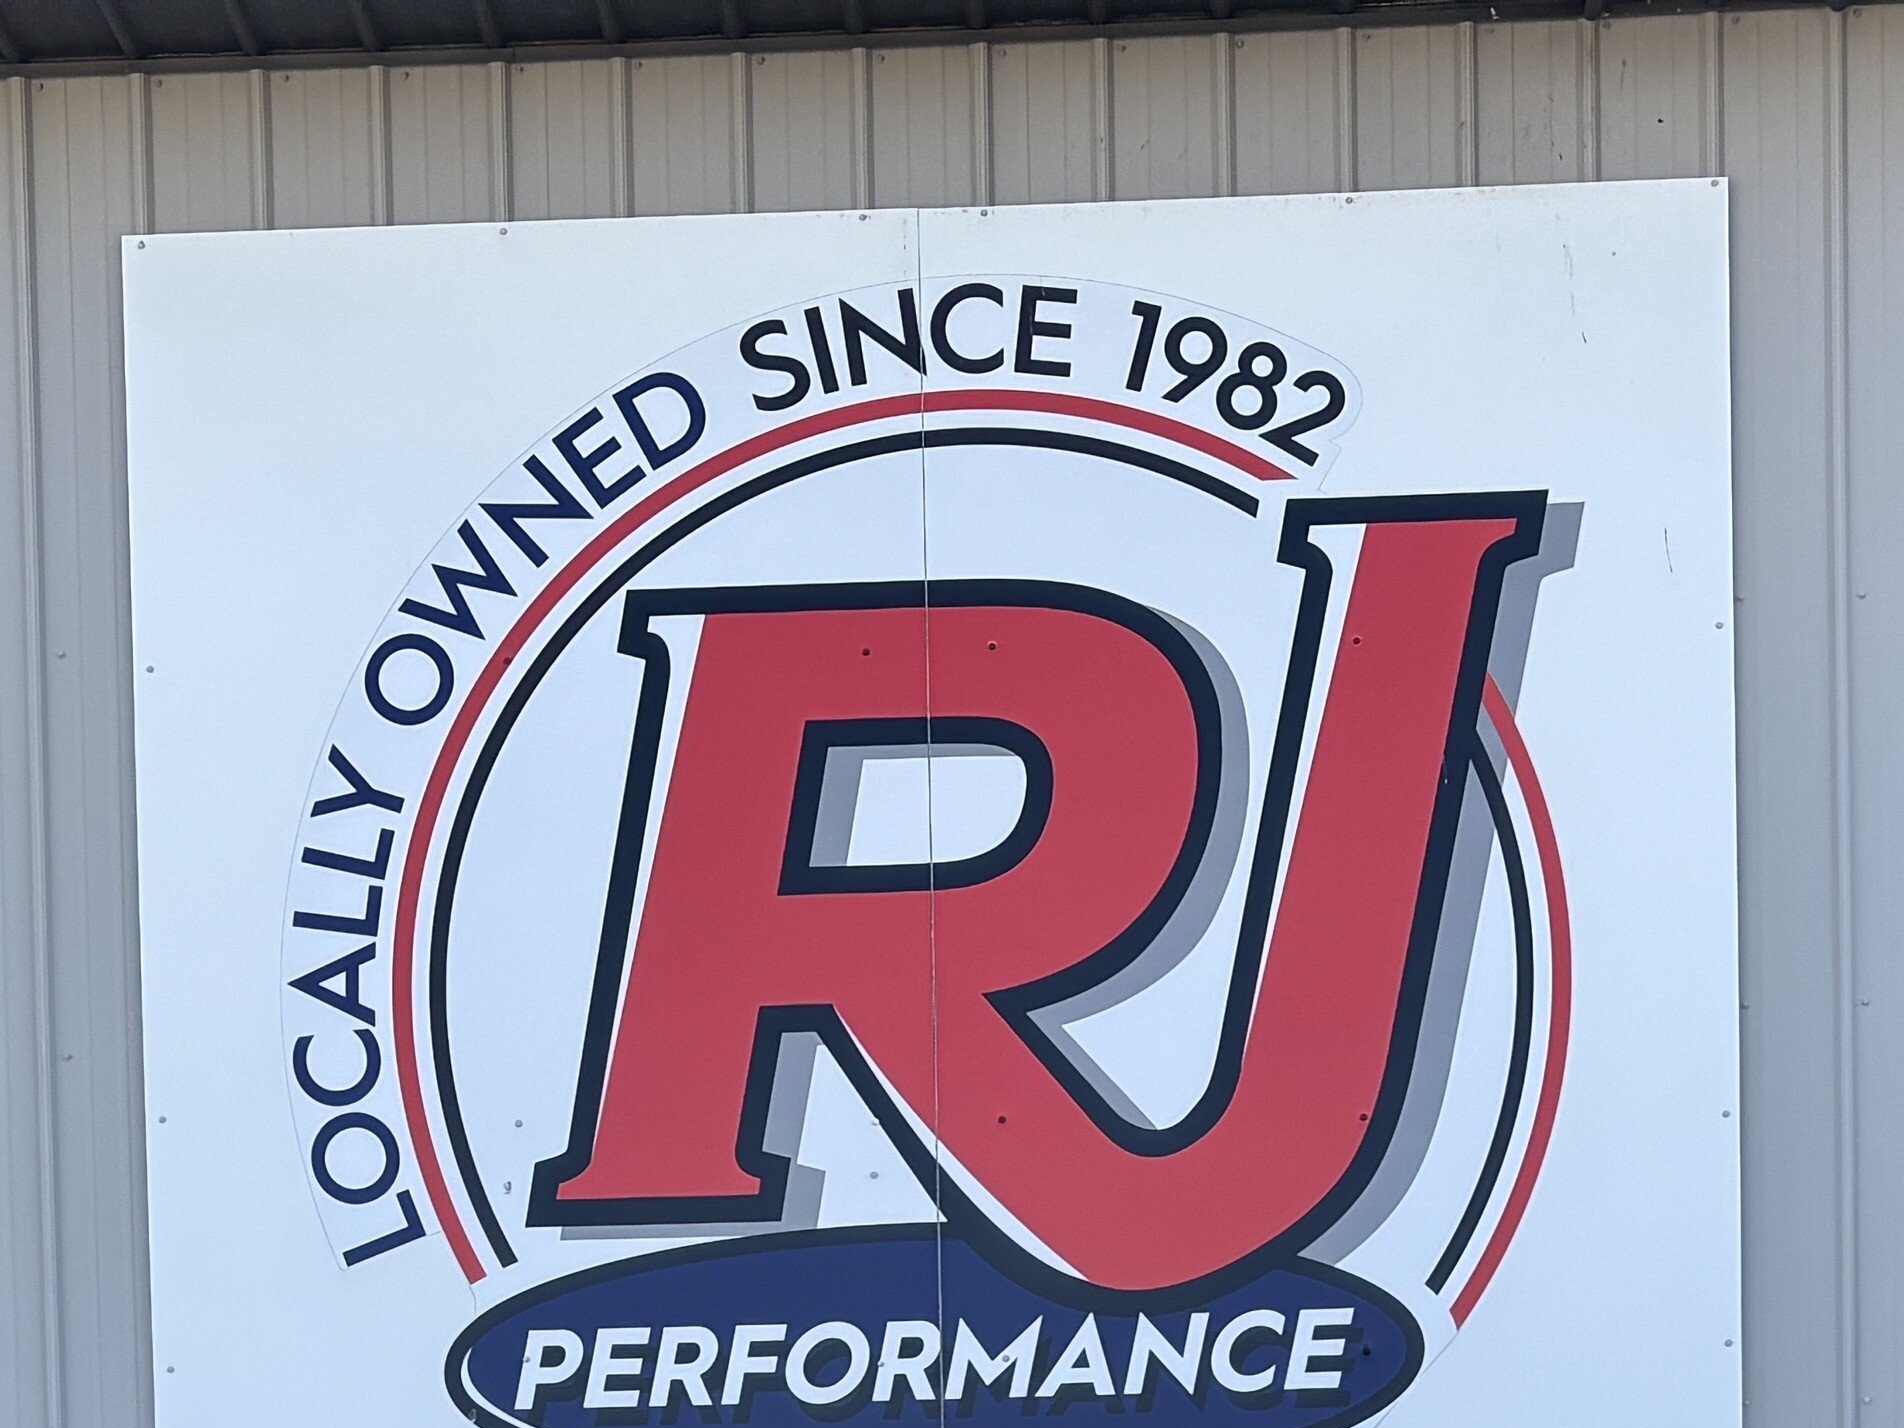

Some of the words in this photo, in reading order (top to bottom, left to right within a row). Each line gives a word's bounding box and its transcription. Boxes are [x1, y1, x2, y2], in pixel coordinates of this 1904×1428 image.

[286, 742, 427, 1268] LOCALLY
[364, 371, 707, 726] OWNED
[739, 282, 1078, 412] SINCE
[1124, 300, 1347, 467] 1982
[526, 488, 1551, 1312] RJ
[512, 1306, 1357, 1411] PERFORMANCE
